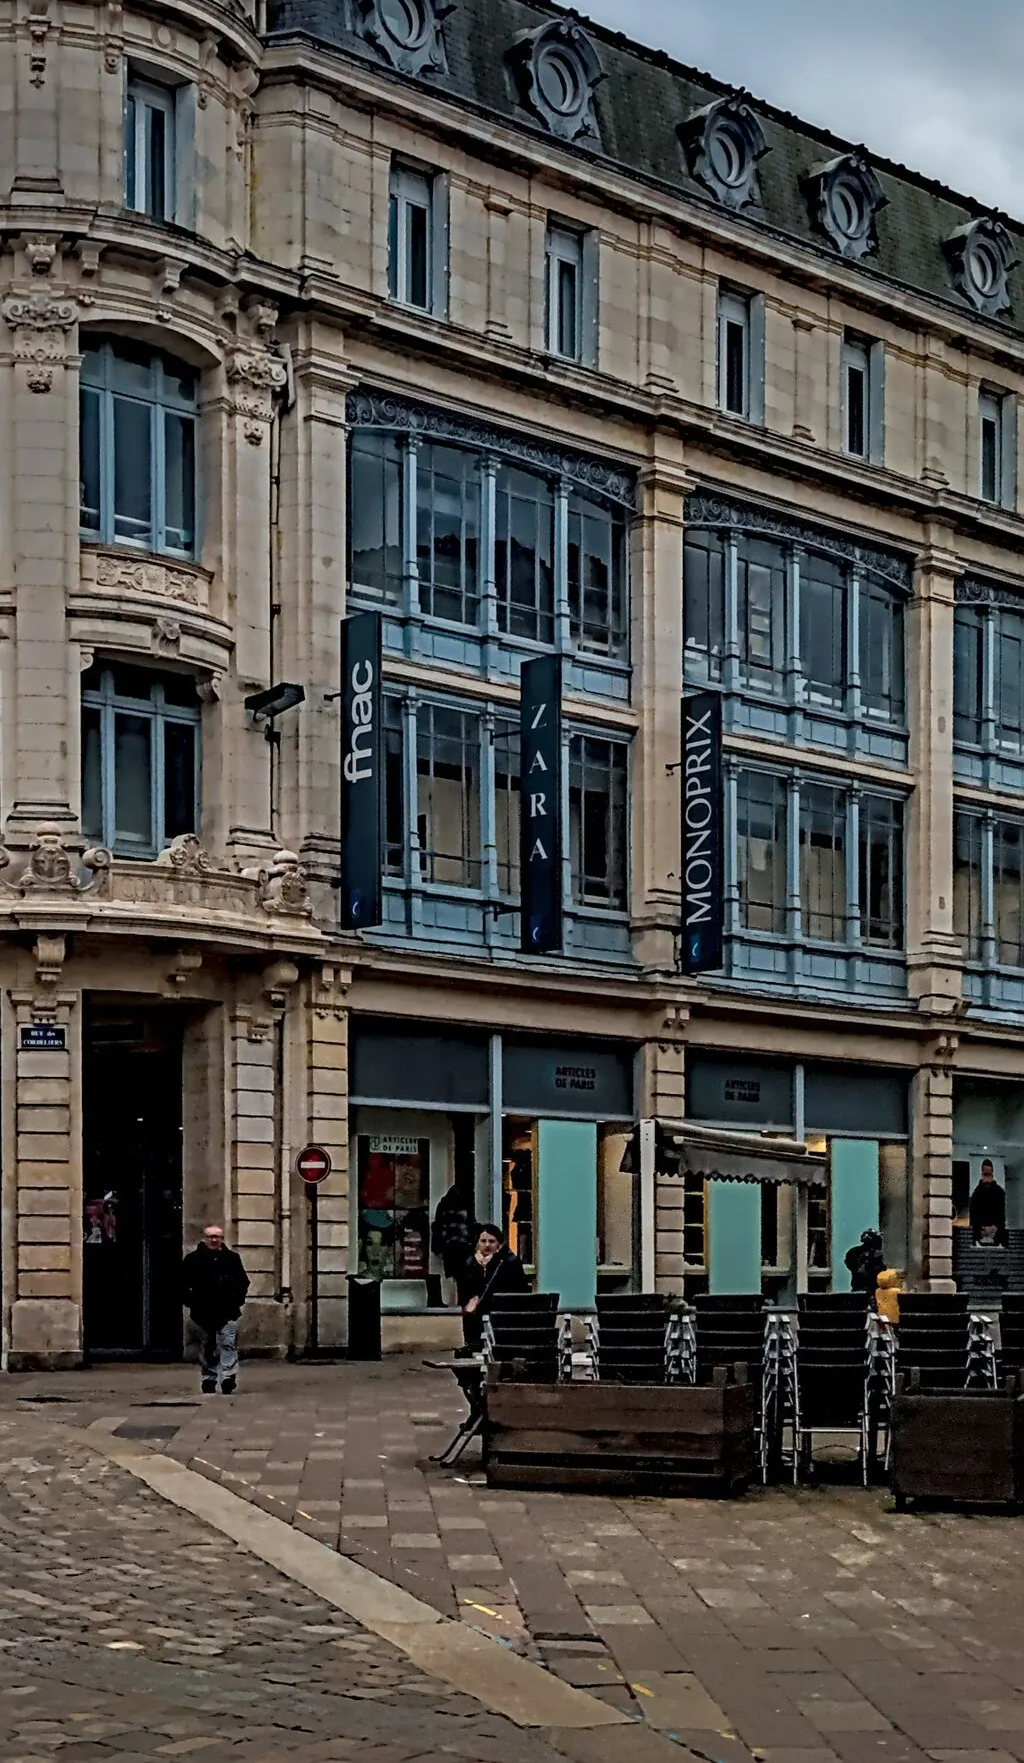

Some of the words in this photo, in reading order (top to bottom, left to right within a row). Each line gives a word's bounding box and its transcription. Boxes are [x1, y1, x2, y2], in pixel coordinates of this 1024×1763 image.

[344, 659, 373, 784] fnac
[528, 703, 549, 862] ZARA
[685, 710, 712, 926] MONOPRIX
[555, 1066, 596, 1079] ARTICLES
[555, 1078, 567, 1089] DE
[570, 1079, 595, 1091] PARIS
